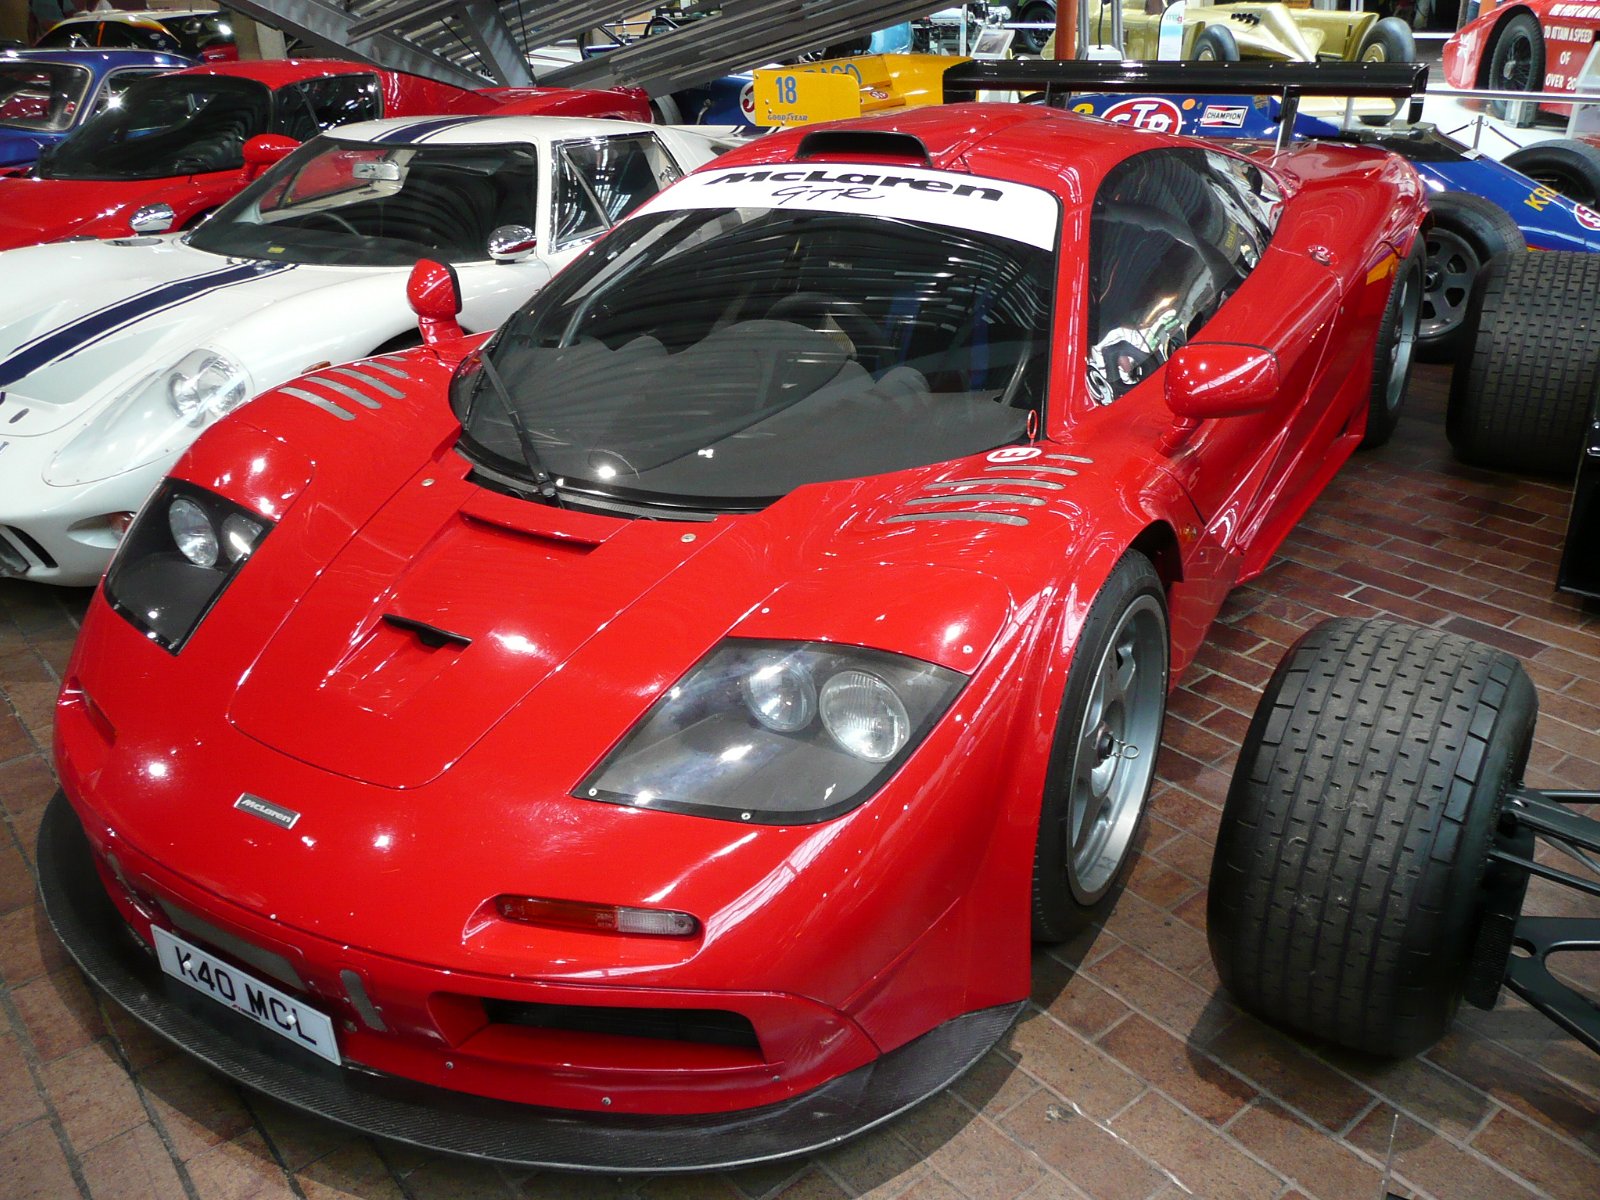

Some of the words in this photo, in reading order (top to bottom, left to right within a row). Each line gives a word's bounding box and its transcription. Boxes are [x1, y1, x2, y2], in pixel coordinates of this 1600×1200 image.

[1551, 26, 1570, 41] ATTAIN
[1573, 28, 1593, 43] SPEED
[1560, 51, 1572, 65] OF
[775, 76, 797, 104] 18
[1545, 73, 1564, 89] OVER
[1206, 112, 1242, 120] CHAMPION
[703, 170, 1004, 202] McLaren
[771, 185, 885, 206] GTR
[241, 799, 292, 823] McLaren
[175, 945, 236, 1002] K40
[245, 983, 317, 1046] MCL
